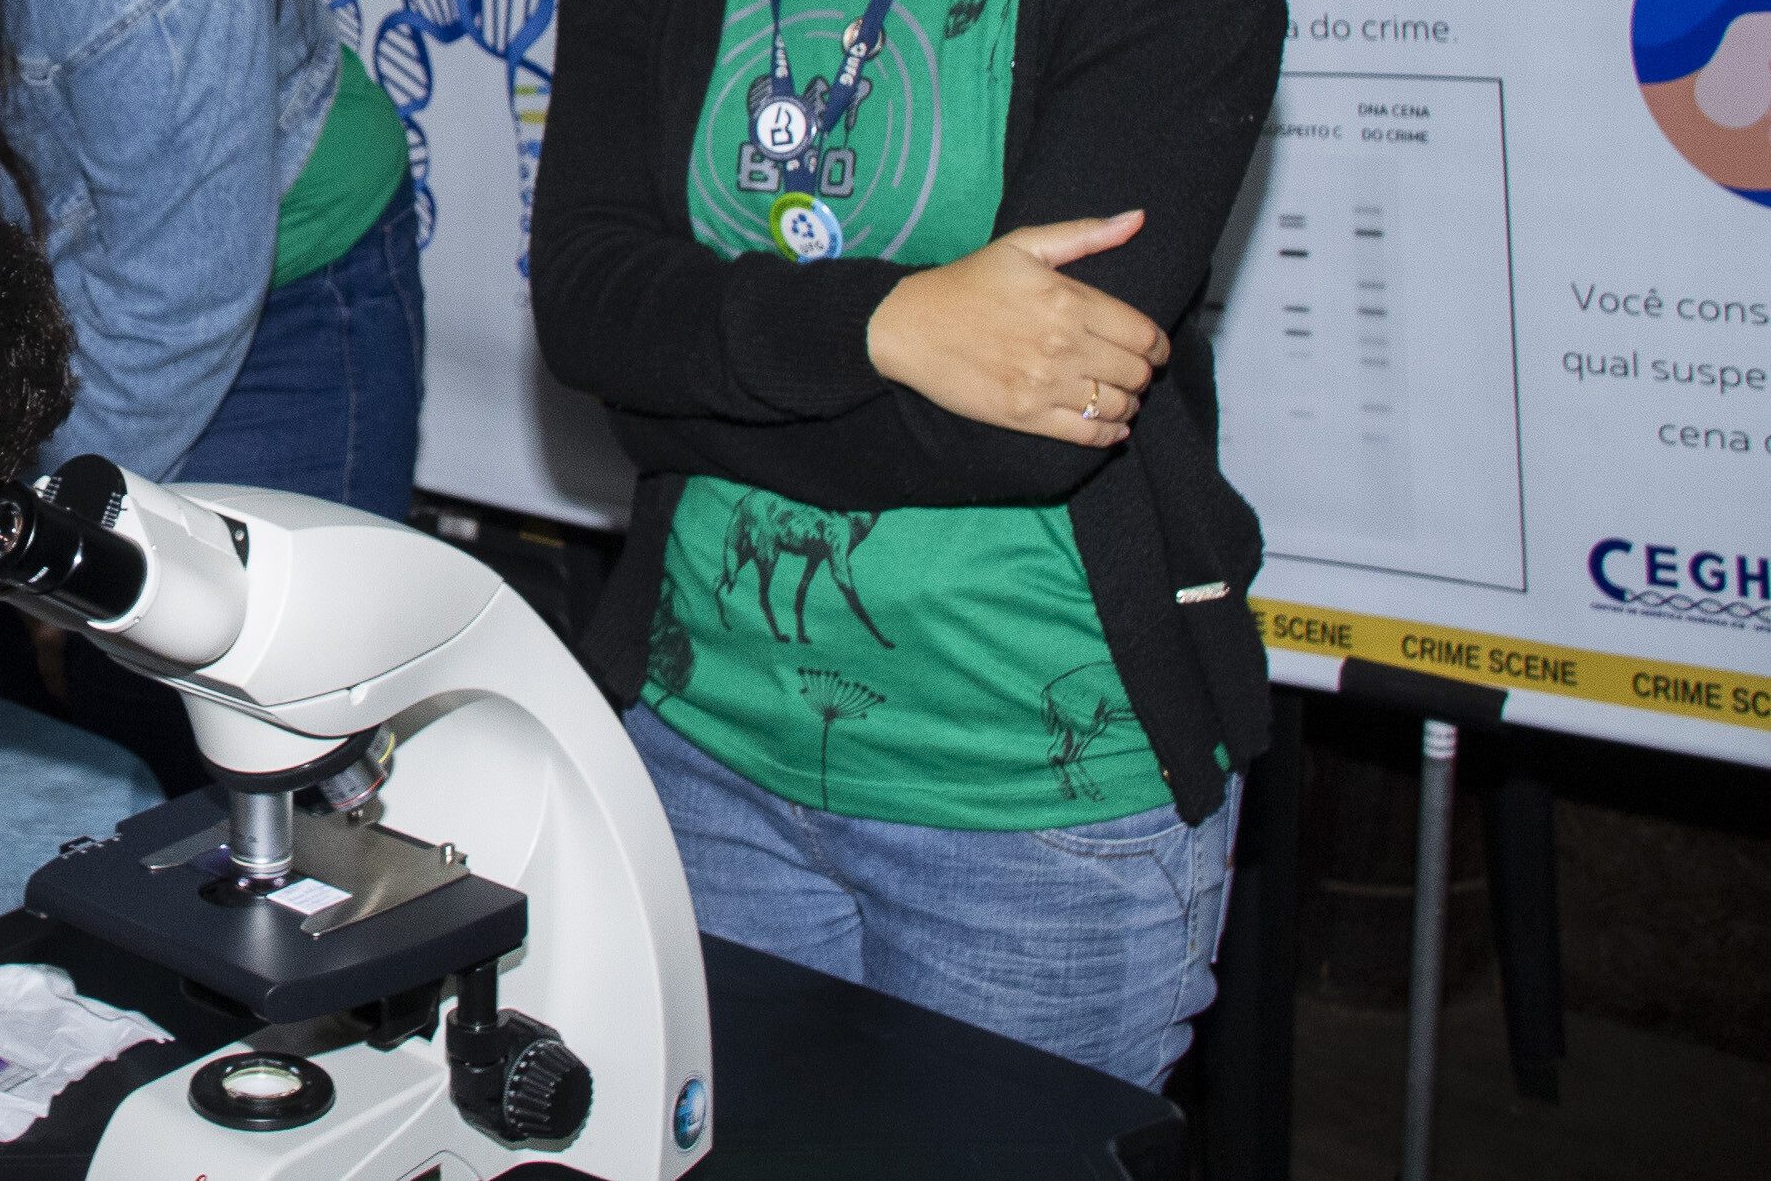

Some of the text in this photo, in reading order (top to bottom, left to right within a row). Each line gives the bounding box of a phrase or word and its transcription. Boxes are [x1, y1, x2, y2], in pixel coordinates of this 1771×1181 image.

[1310, 13, 1351, 42] do
[1358, 103, 1431, 120] DNA CENA
[1361, 127, 1429, 145] DO CRIME
[736, 141, 857, 199] BO
[1571, 282, 1771, 326] Você cons
[1563, 350, 1768, 396] qual suspe
[1658, 423, 1751, 453] cena
[1587, 537, 1771, 604] CEGH
[1273, 614, 1354, 649] SCENE
[1401, 633, 1482, 670] CRIME
[1489, 648, 1578, 687] SCENE
[1633, 672, 1723, 710] CRIME
